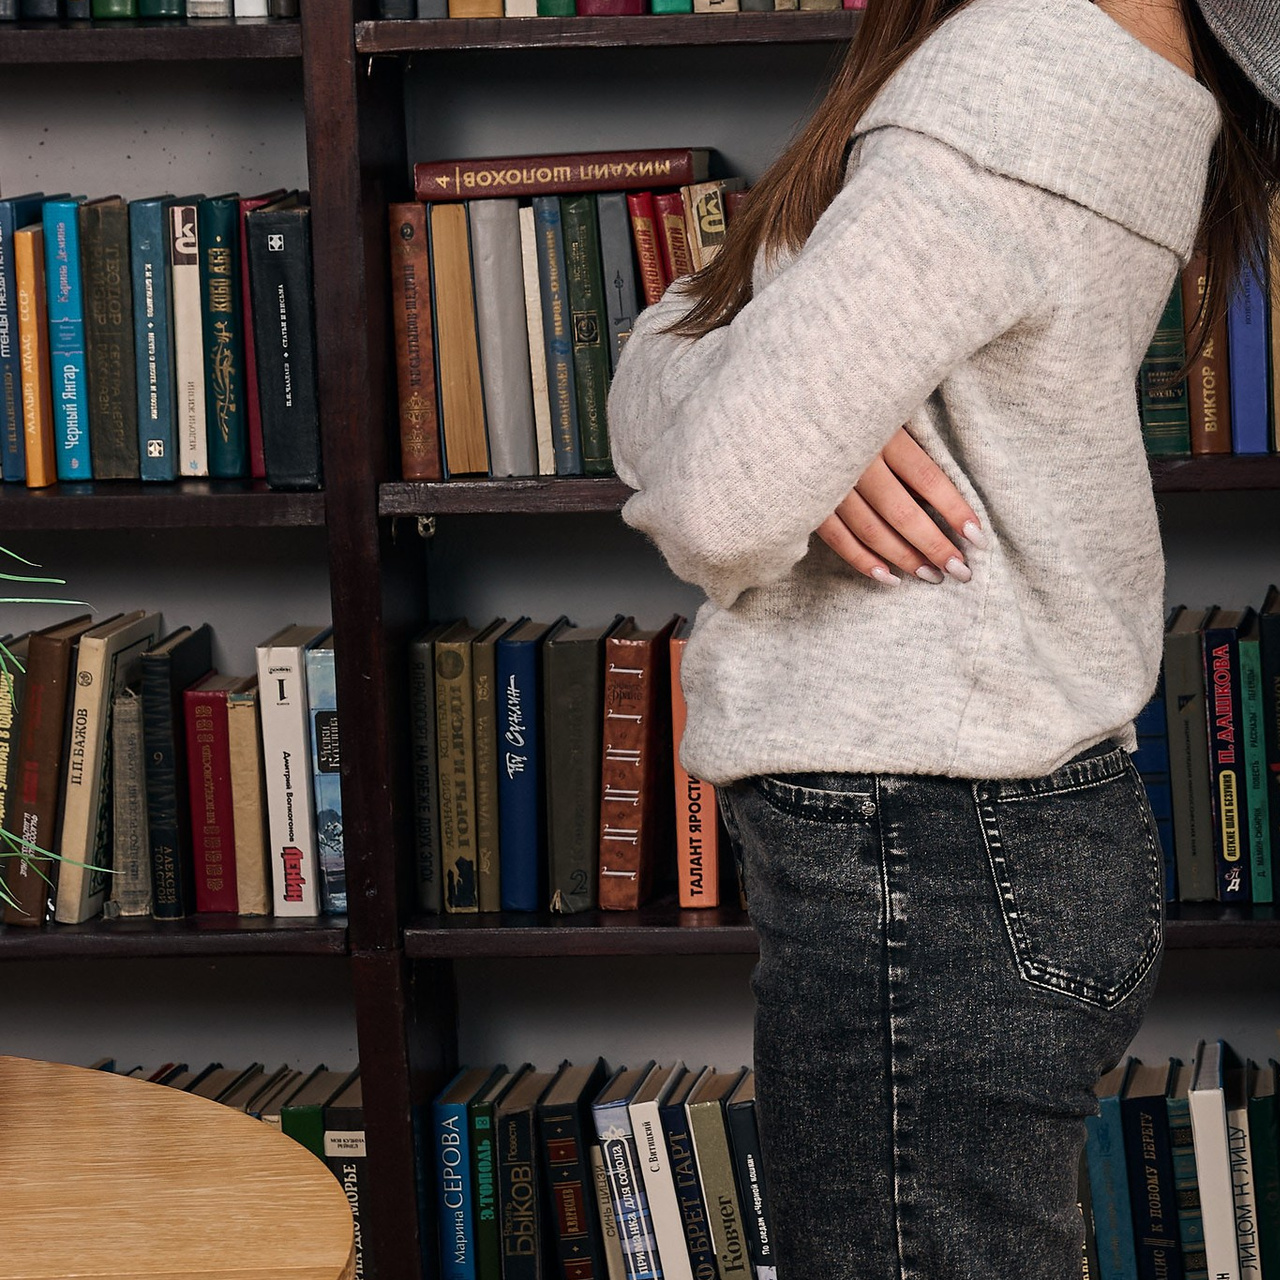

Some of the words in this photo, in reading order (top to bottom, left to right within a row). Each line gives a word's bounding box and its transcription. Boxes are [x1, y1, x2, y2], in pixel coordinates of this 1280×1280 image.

[435, 176, 450, 189] 4
[463, 165, 572, 187] ШОЛОХОВ
[579, 159, 671, 179] МИХАИЛ
[56, 222, 68, 262] Демина
[208, 247, 230, 275] АБЭ
[56, 265, 70, 303] Карина
[211, 278, 232, 313] КОБО
[19, 289, 29, 321] СССР
[21, 334, 33, 373] АТЛАС
[61, 364, 80, 400] Янгар
[186, 380, 197, 413] ЖИЗНИ
[1203, 366, 1219, 432] ВИКТОР
[23, 382, 37, 434] МАЛЫЙ
[62, 404, 83, 449] Черный
[187, 415, 198, 451] МЕЛОЧИ
[1213, 643, 1236, 743] ДАШКОВА
[450, 684, 466, 755] ЛЮДИ
[282, 751, 293, 790] Дмитрий
[455, 758, 467, 774] И
[1218, 744, 1236, 764] П.
[1223, 773, 1235, 807] БЕЗУМИЯ
[285, 792, 294, 842] Волкогонов
[456, 780, 470, 848] ГОРЫ
[1224, 808, 1236, 829] ШАГИ
[1224, 830, 1237, 857] ЛЕГКИЕ
[154, 846, 164, 904] ТОЛСТОЙ
[163, 846, 175, 904] АЛЕКСЕЙ
[281, 846, 305, 903] ЛЕНИН
[689, 839, 703, 896] ТАЛАНТ
[506, 1121, 519, 1161] Повести
[641, 1121, 660, 1163] Витицкий
[669, 1131, 697, 1188] ГАРТ
[1229, 1126, 1248, 1174] ЛИЦУ
[441, 1115, 465, 1208] СЕРОВА
[595, 1165, 611, 1204] ЦИЦЗИ
[1235, 1181, 1250, 1196] К
[506, 1166, 536, 1256] БЫКОВ
[602, 1207, 616, 1237] СИНЬ
[451, 1210, 467, 1265] Марина
[716, 1195, 746, 1272] Ковчег
[1236, 1204, 1258, 1270] ЛИЦОМ
